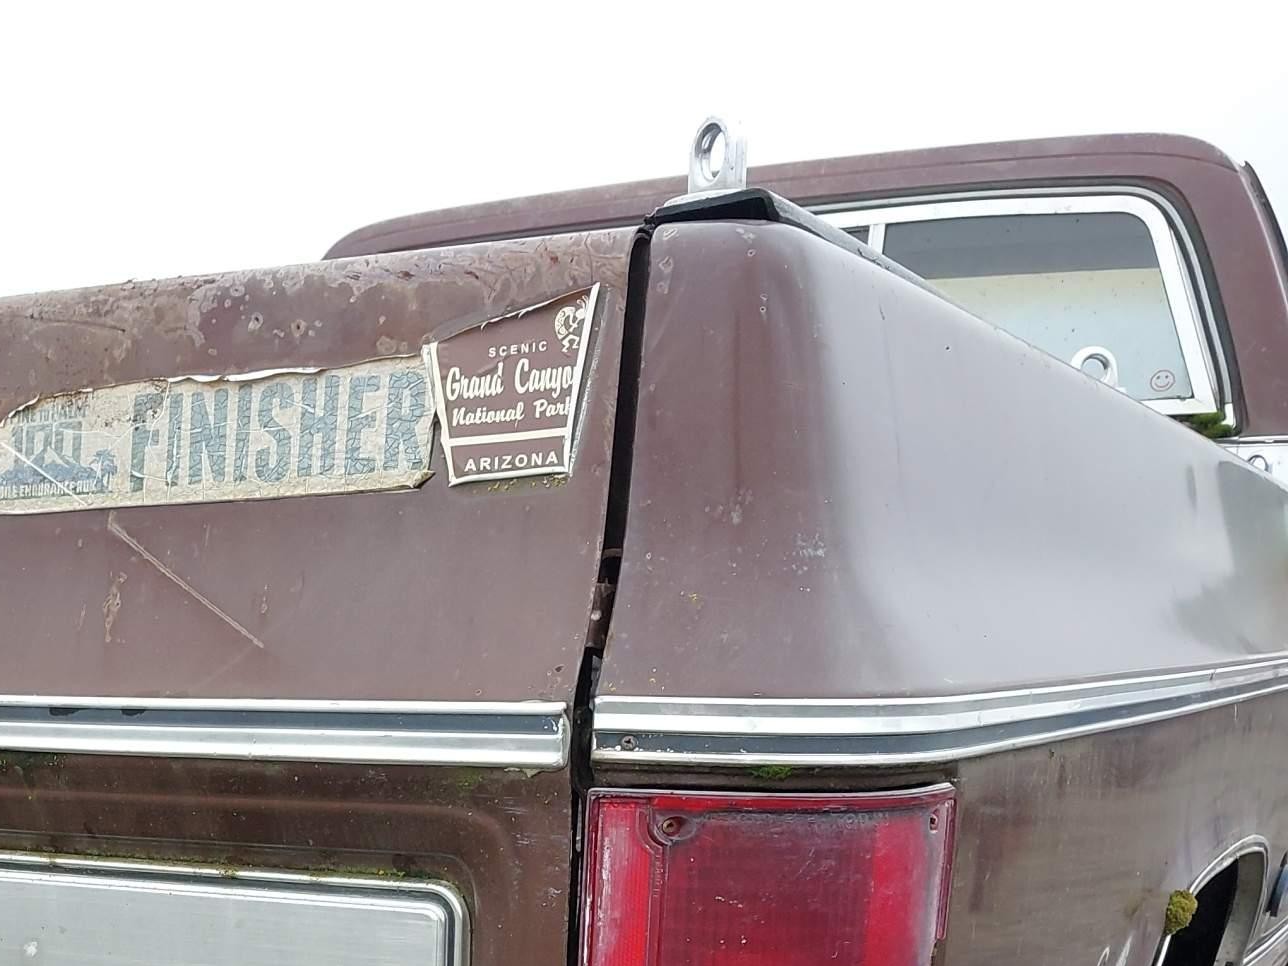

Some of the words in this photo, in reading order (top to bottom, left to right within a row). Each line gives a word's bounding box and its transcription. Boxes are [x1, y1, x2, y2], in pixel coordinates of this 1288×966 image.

[488, 340, 548, 359] SCENIC
[446, 360, 504, 401] Grand
[452, 401, 525, 427] National
[130, 370, 426, 492] FINISHER
[464, 451, 559, 473] ARIZONA
